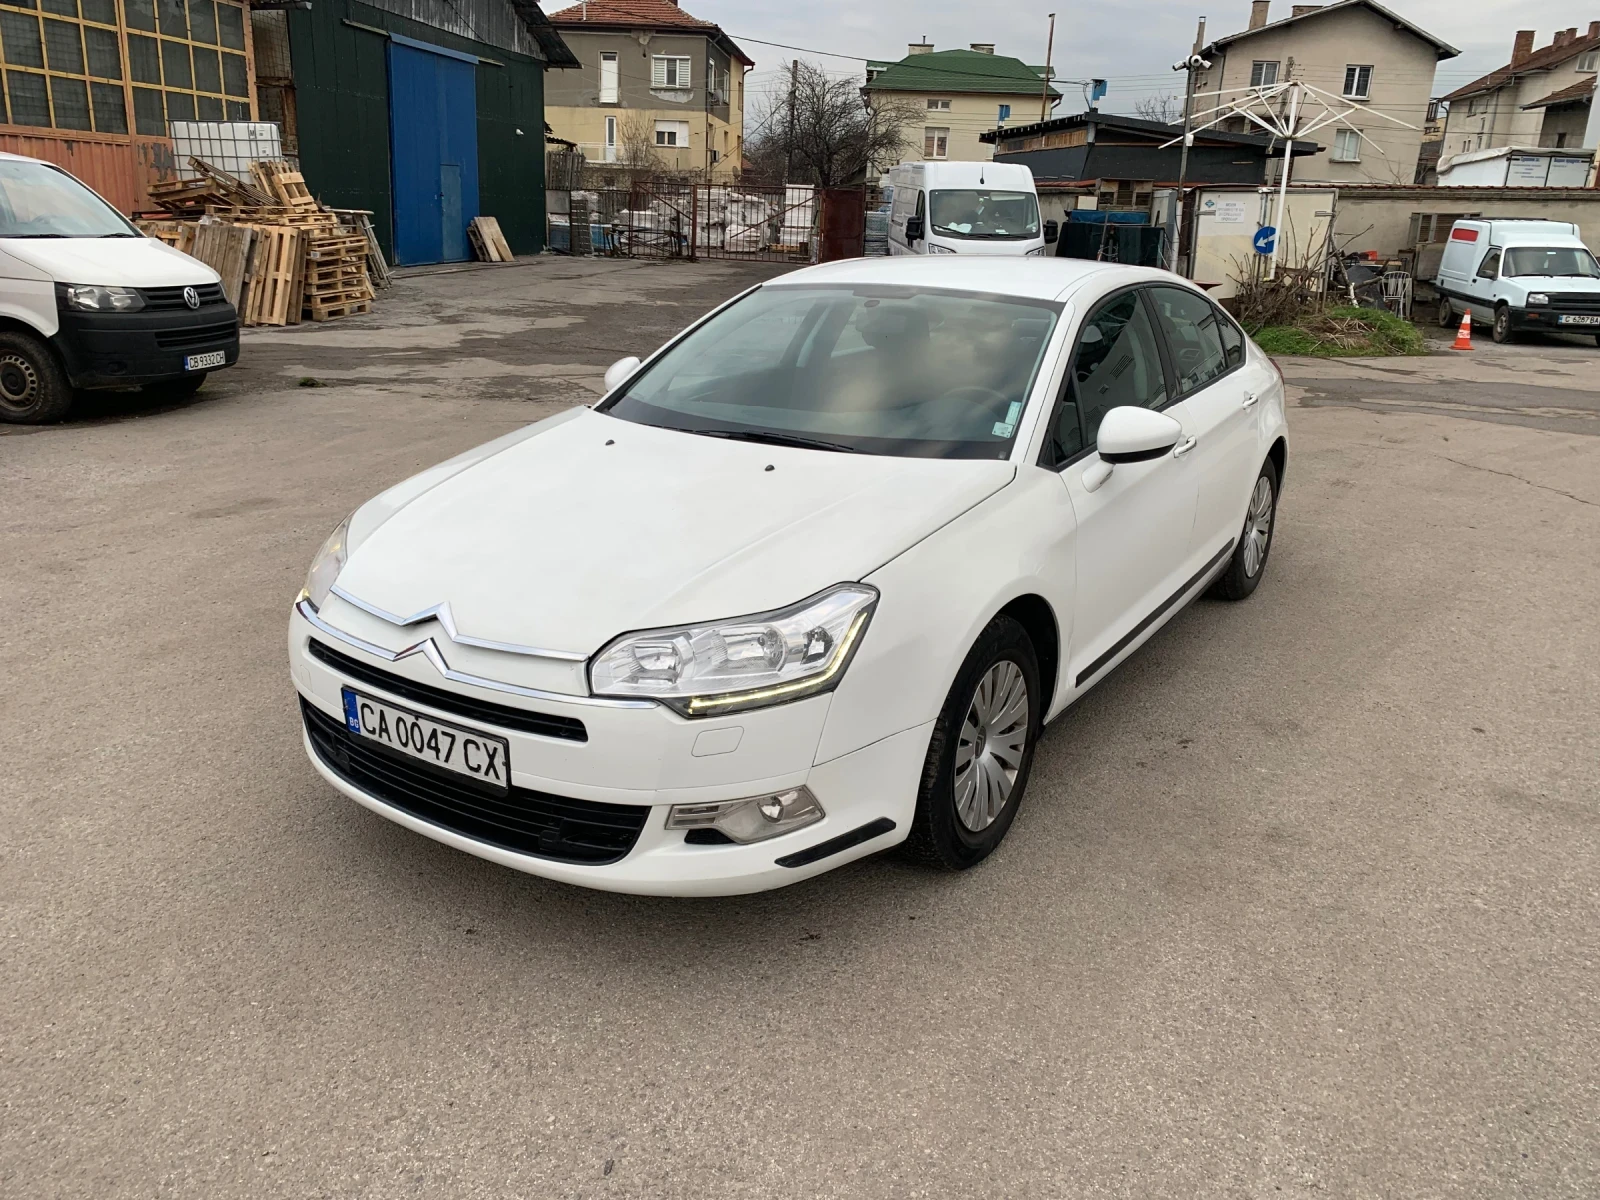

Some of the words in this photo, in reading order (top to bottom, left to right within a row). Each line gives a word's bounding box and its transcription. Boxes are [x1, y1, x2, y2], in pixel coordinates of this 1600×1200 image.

[1572, 316, 1590, 324] 6287
[190, 356, 199, 369] CB
[200, 354, 215, 367] 9332
[216, 351, 225, 364] CH
[349, 716, 359, 729] BG
[360, 702, 392, 743] CA
[396, 716, 456, 763] 0047
[463, 738, 500, 780] CX
